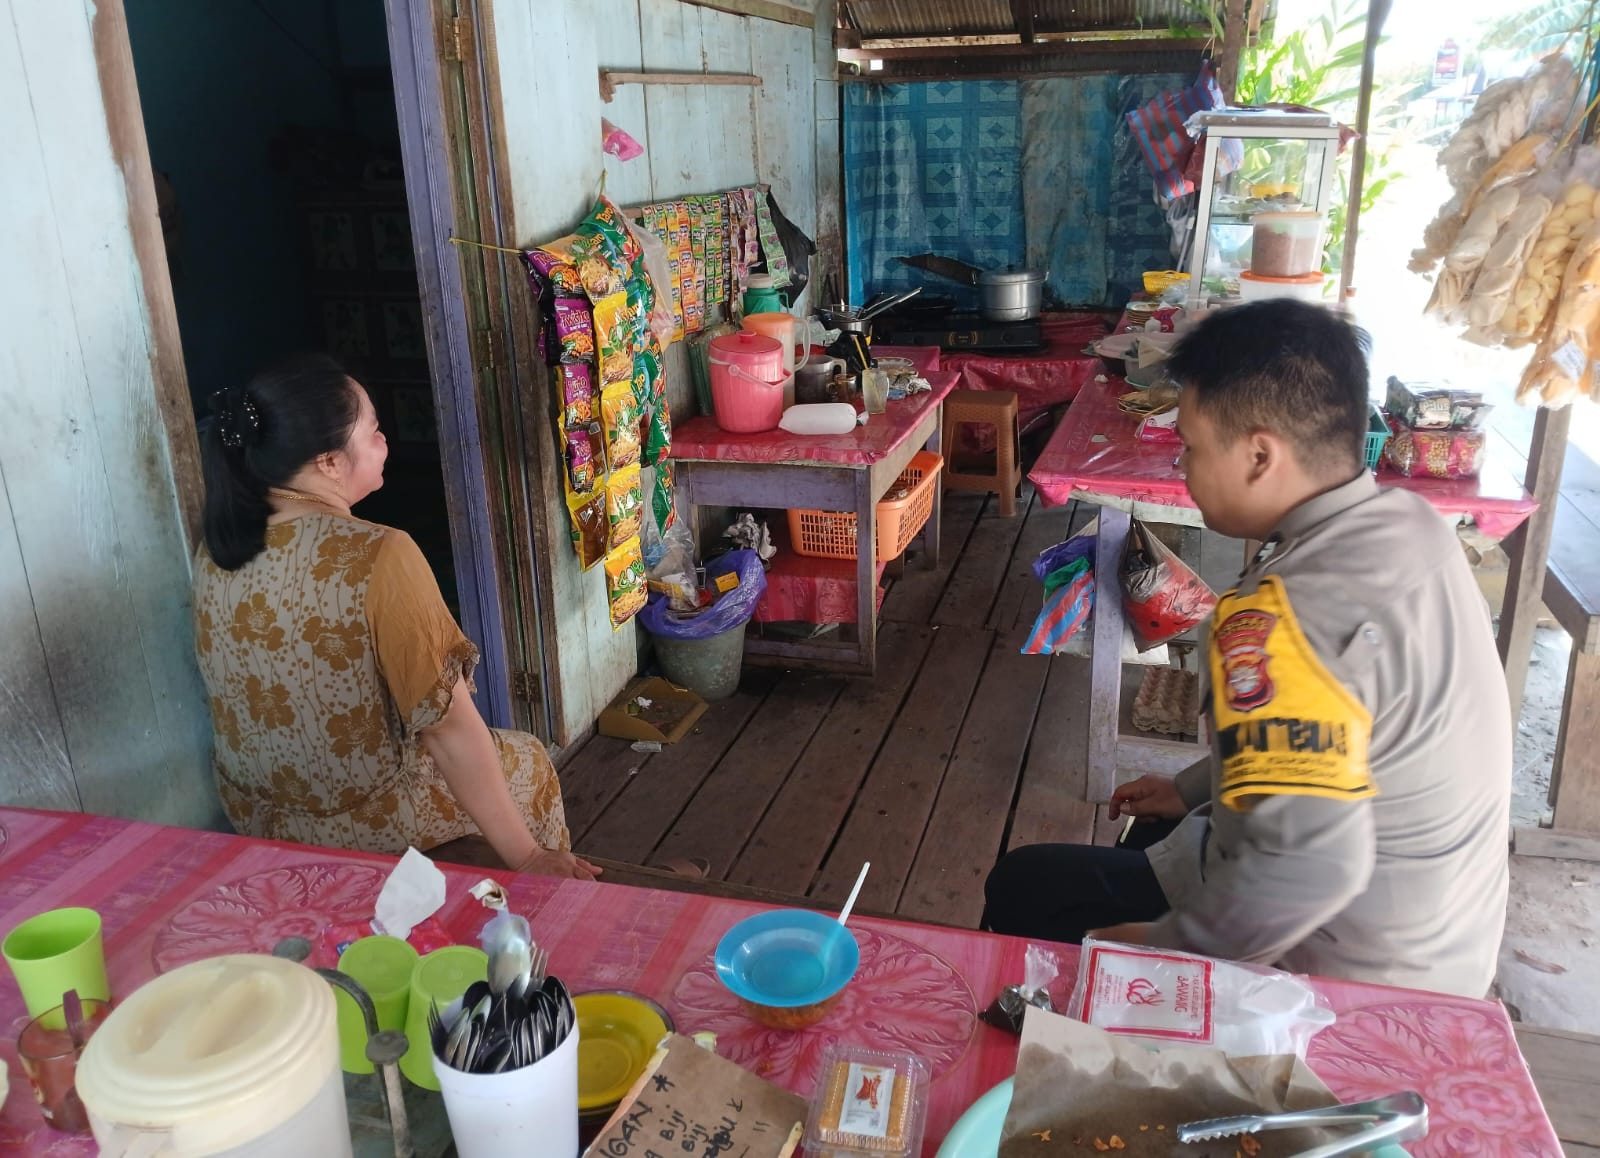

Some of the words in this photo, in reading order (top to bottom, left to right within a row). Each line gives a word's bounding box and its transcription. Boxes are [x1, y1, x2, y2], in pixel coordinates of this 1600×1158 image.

[595, 207, 614, 223] Taro
[589, 233, 606, 245] aro
[1174, 975, 1189, 1012] BAWANG
